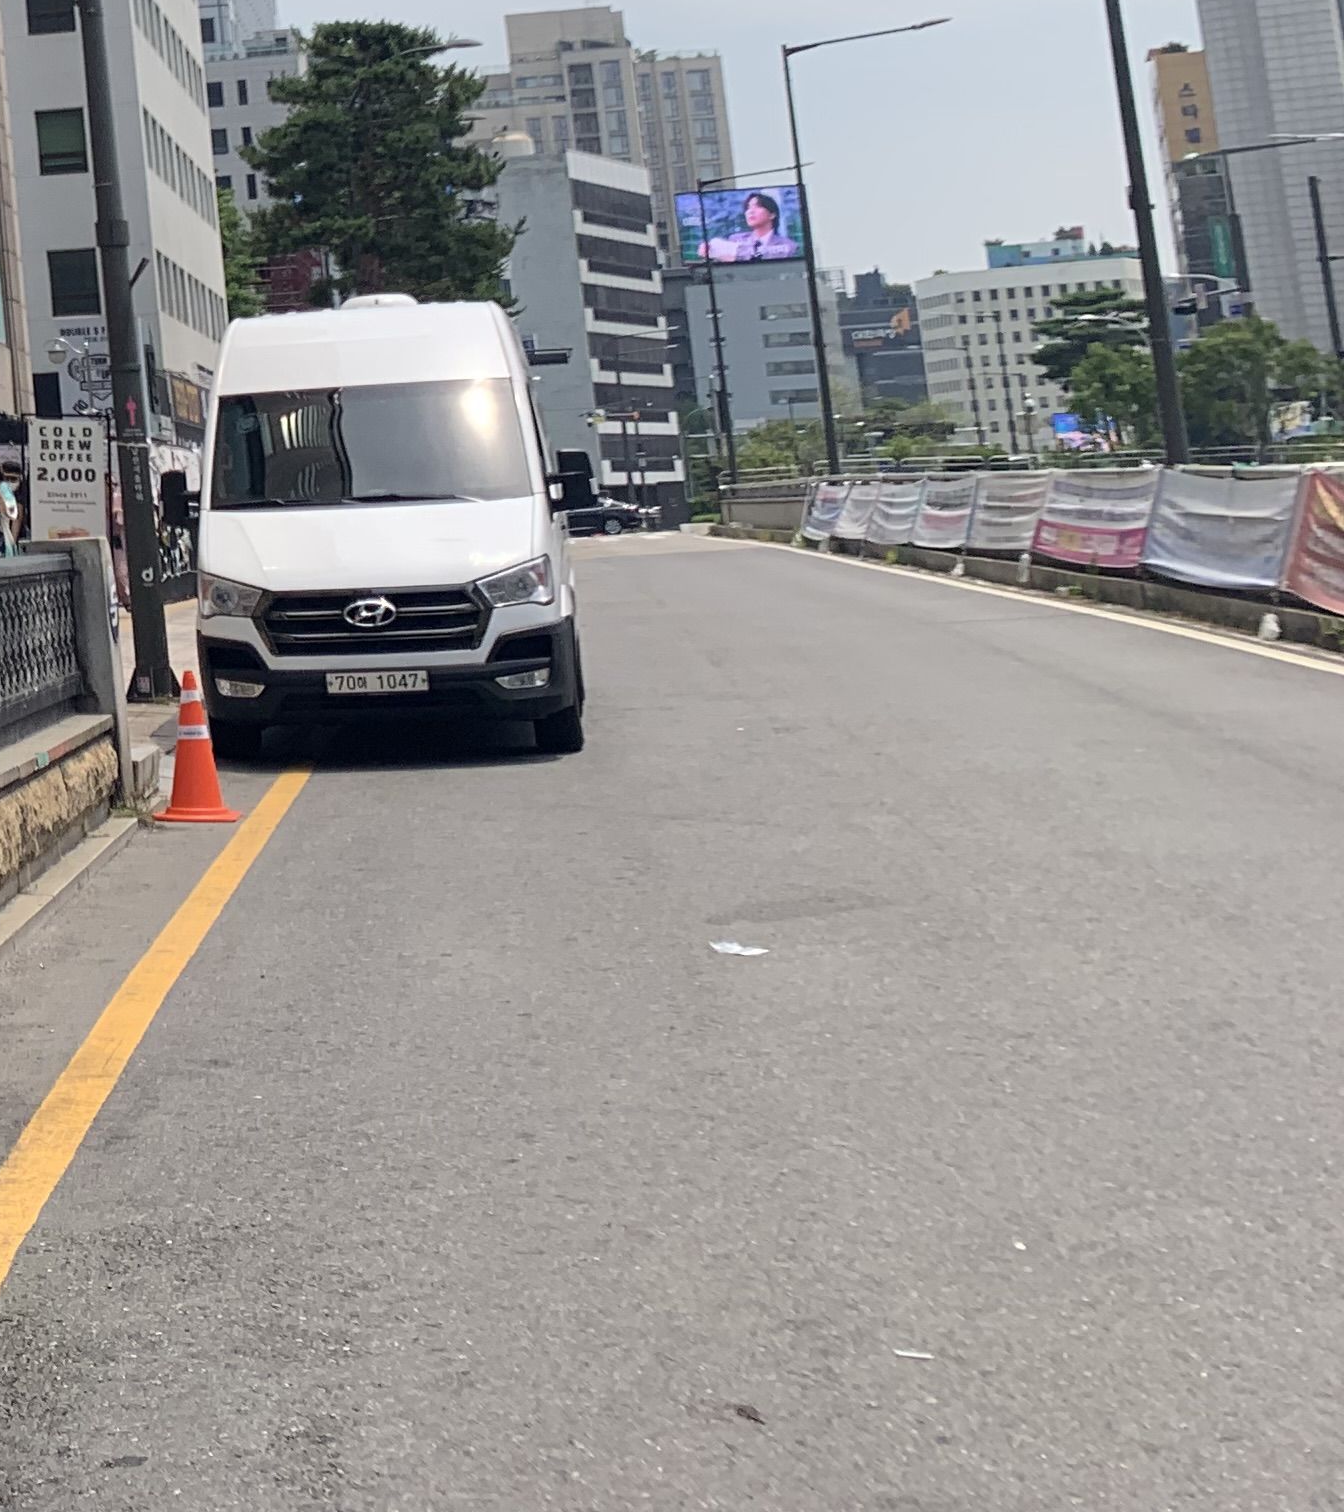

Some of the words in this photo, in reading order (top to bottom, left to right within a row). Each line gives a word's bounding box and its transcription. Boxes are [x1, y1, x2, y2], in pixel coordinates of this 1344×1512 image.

[39, 426, 93, 438] COLD
[40, 439, 92, 451] BREW
[39, 452, 93, 463] COFFEE
[376, 673, 419, 690] 1047
